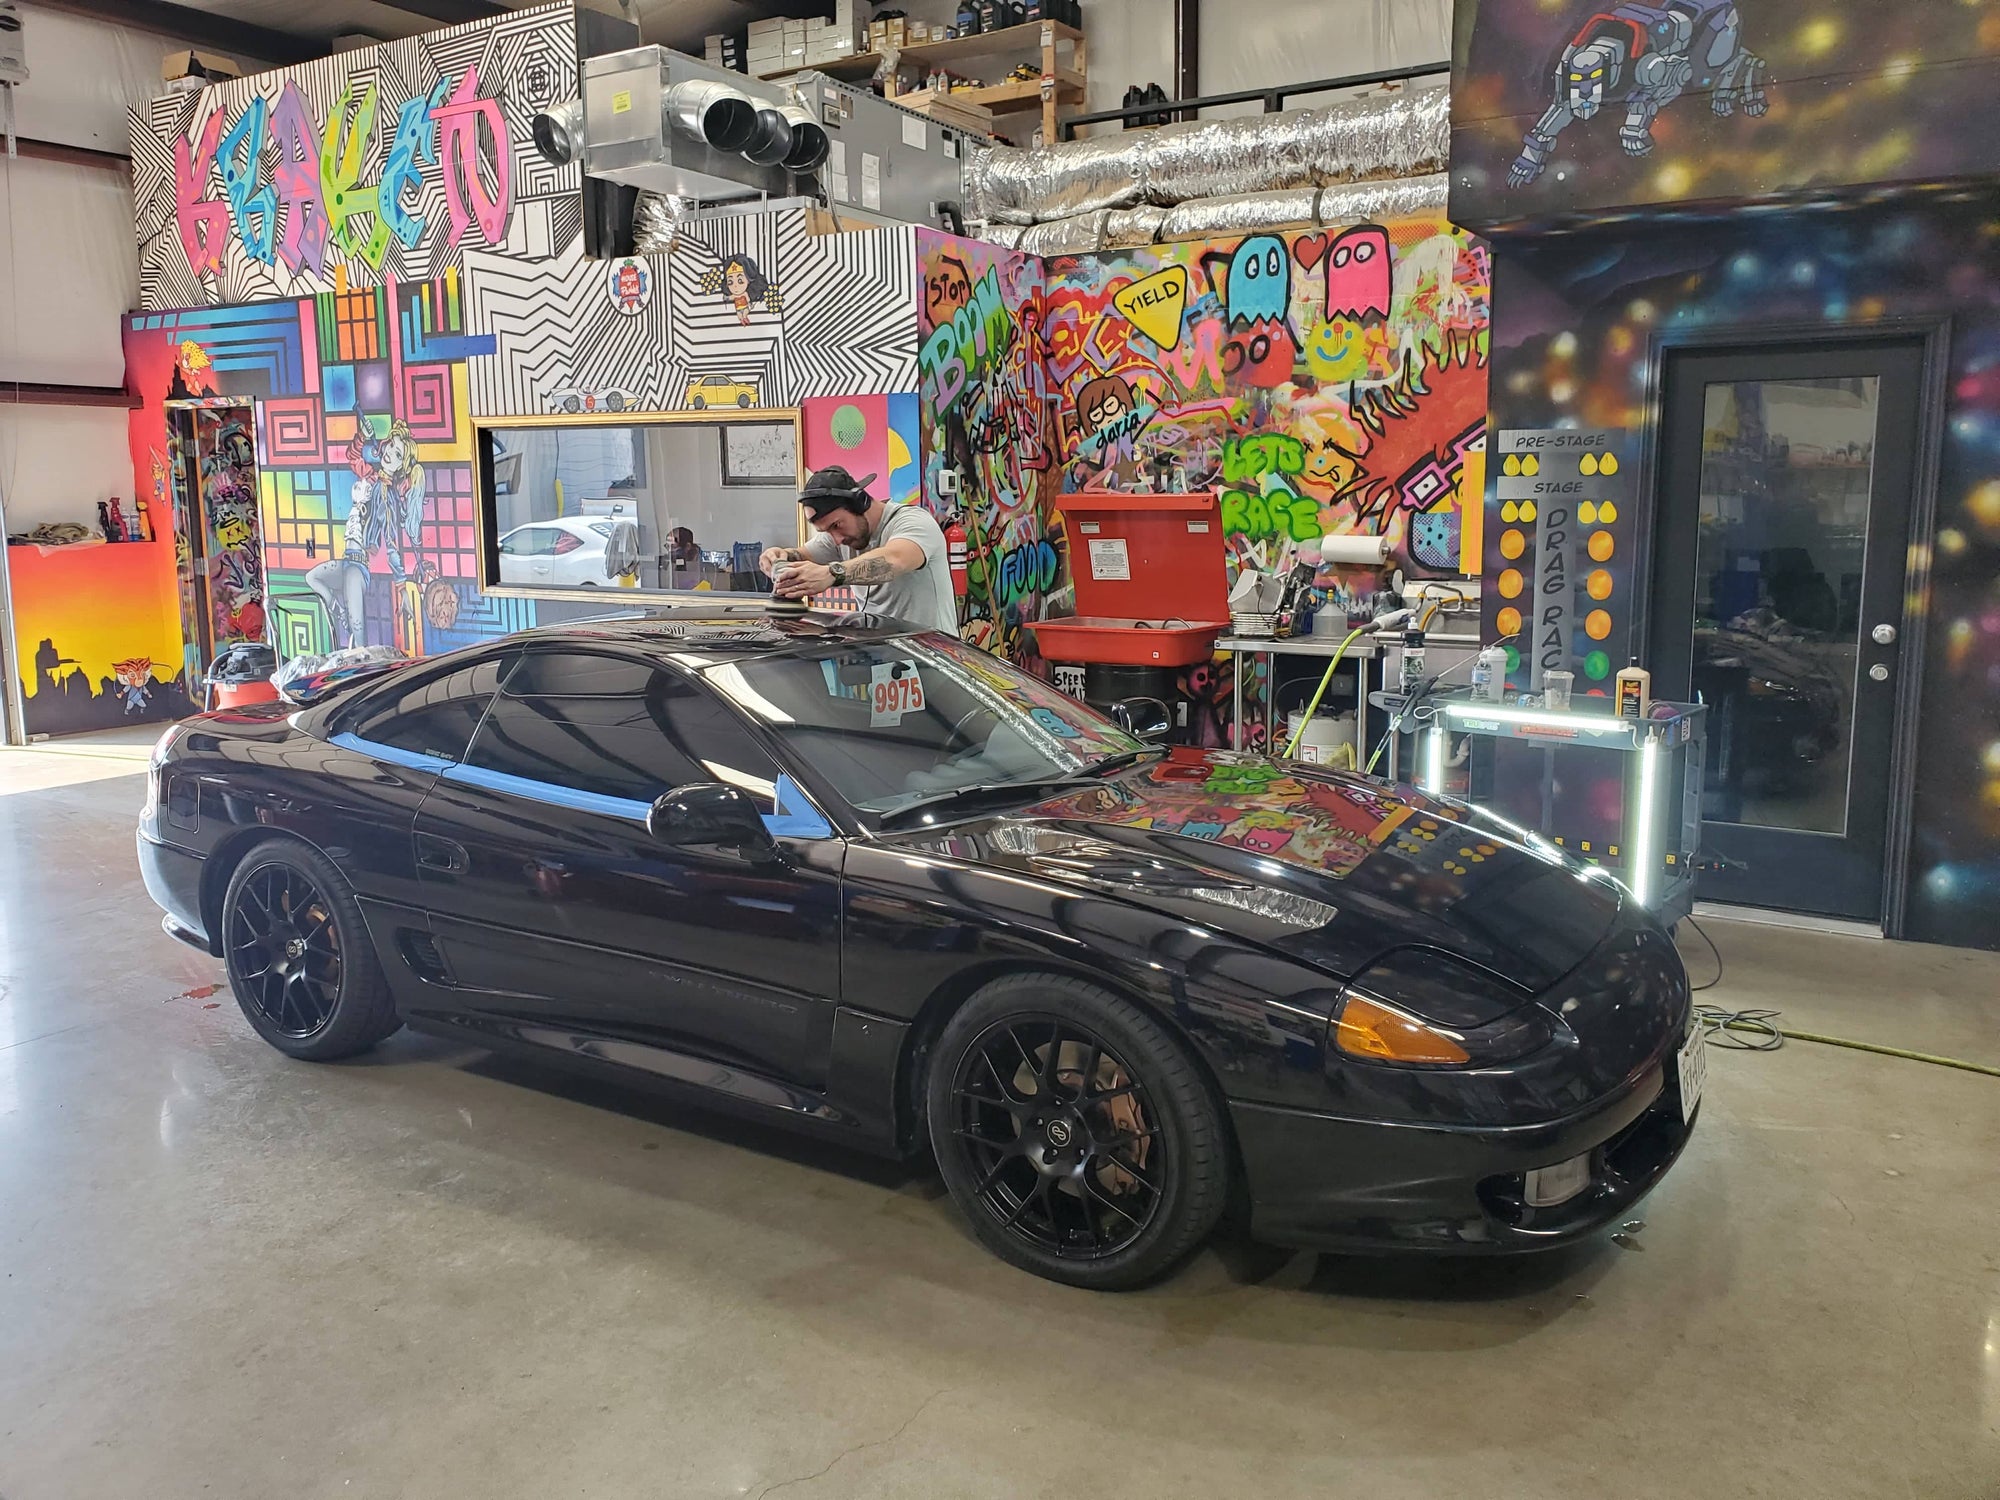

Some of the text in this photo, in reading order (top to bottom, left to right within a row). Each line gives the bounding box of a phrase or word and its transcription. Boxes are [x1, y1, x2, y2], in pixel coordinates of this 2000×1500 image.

[931, 274, 966, 307] STOP
[1124, 281, 1180, 315] YIELD
[918, 263, 1011, 427] BOOM
[1096, 412, 1142, 449] daria
[1515, 434, 1605, 448] PRE-STAGE
[1223, 432, 1305, 482] LETS
[1533, 481, 1584, 494] STAGE
[1542, 508, 1568, 595] DRAG
[1000, 539, 1057, 608] FOOD
[875, 677, 922, 713] 9975
